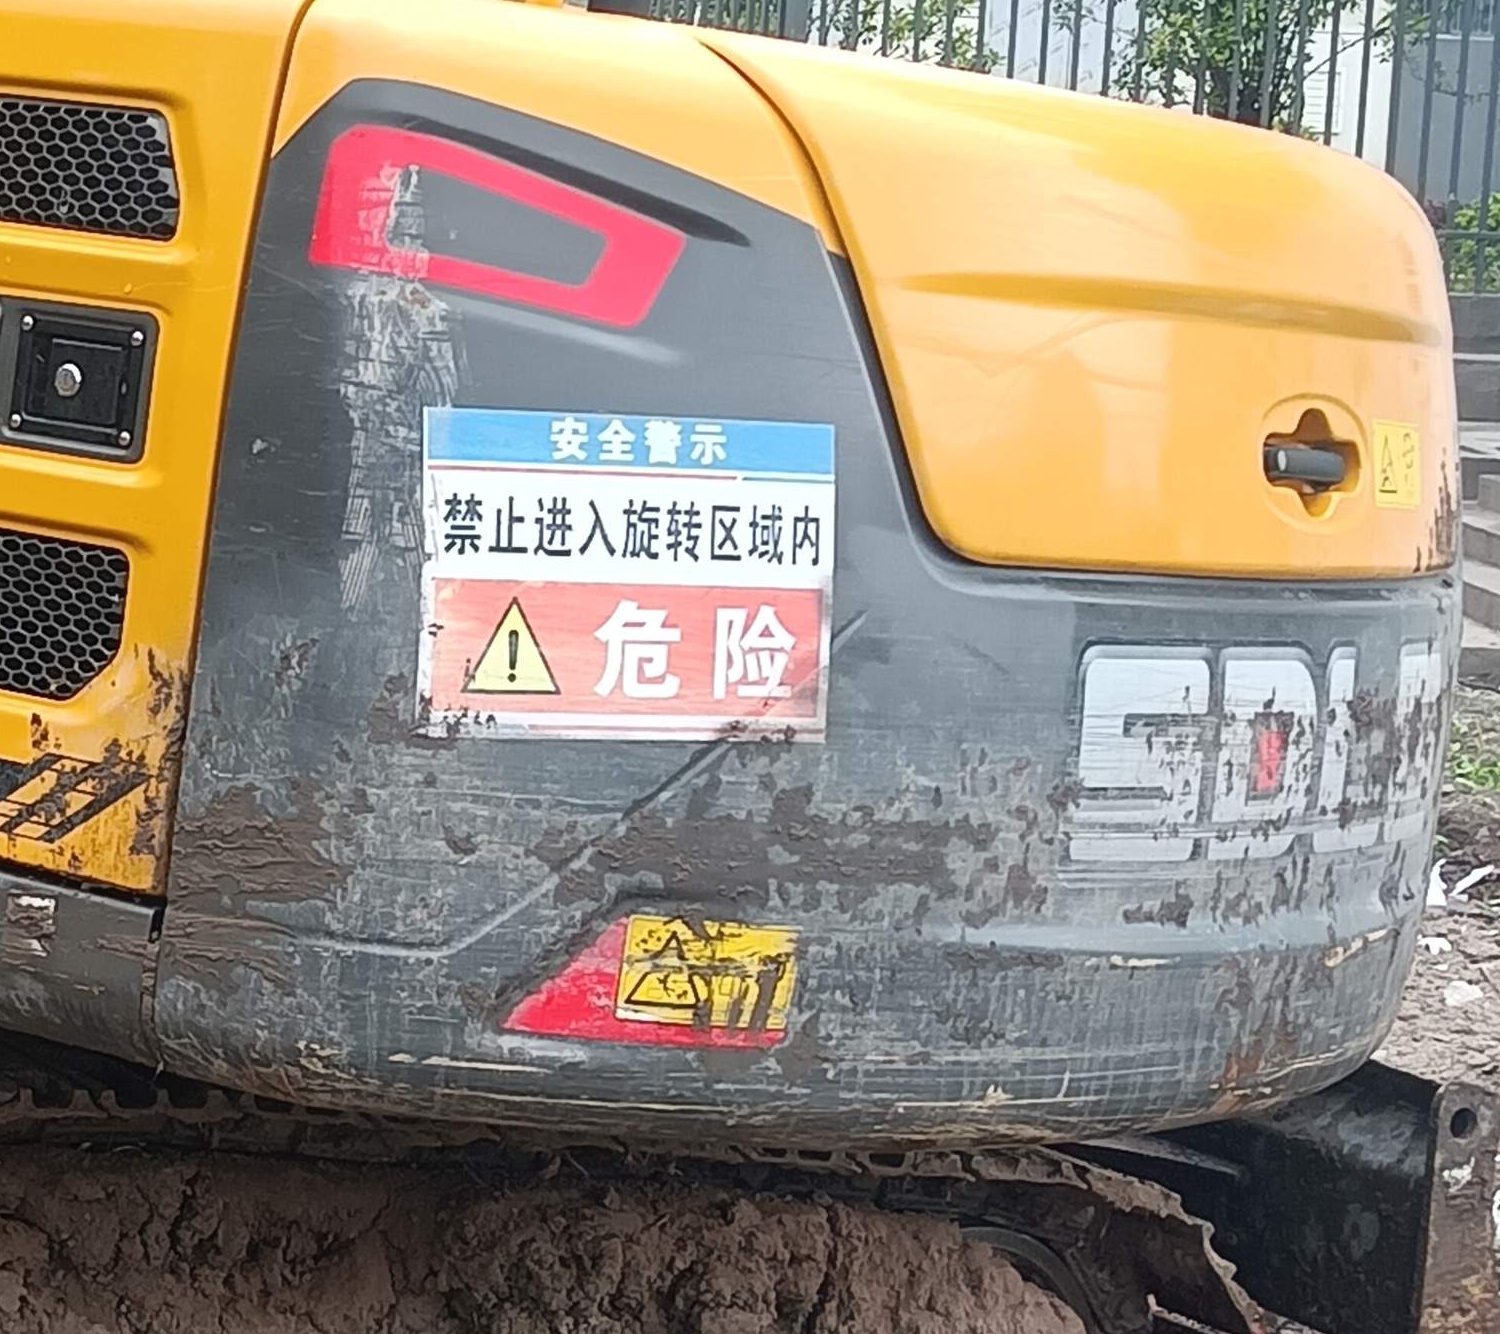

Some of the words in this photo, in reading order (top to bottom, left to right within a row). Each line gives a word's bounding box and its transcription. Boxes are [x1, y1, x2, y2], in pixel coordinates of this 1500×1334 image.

[550, 416, 728, 466] 安全警示
[443, 492, 821, 566] 禁止进入旋转区域内
[593, 599, 796, 700] 危险
